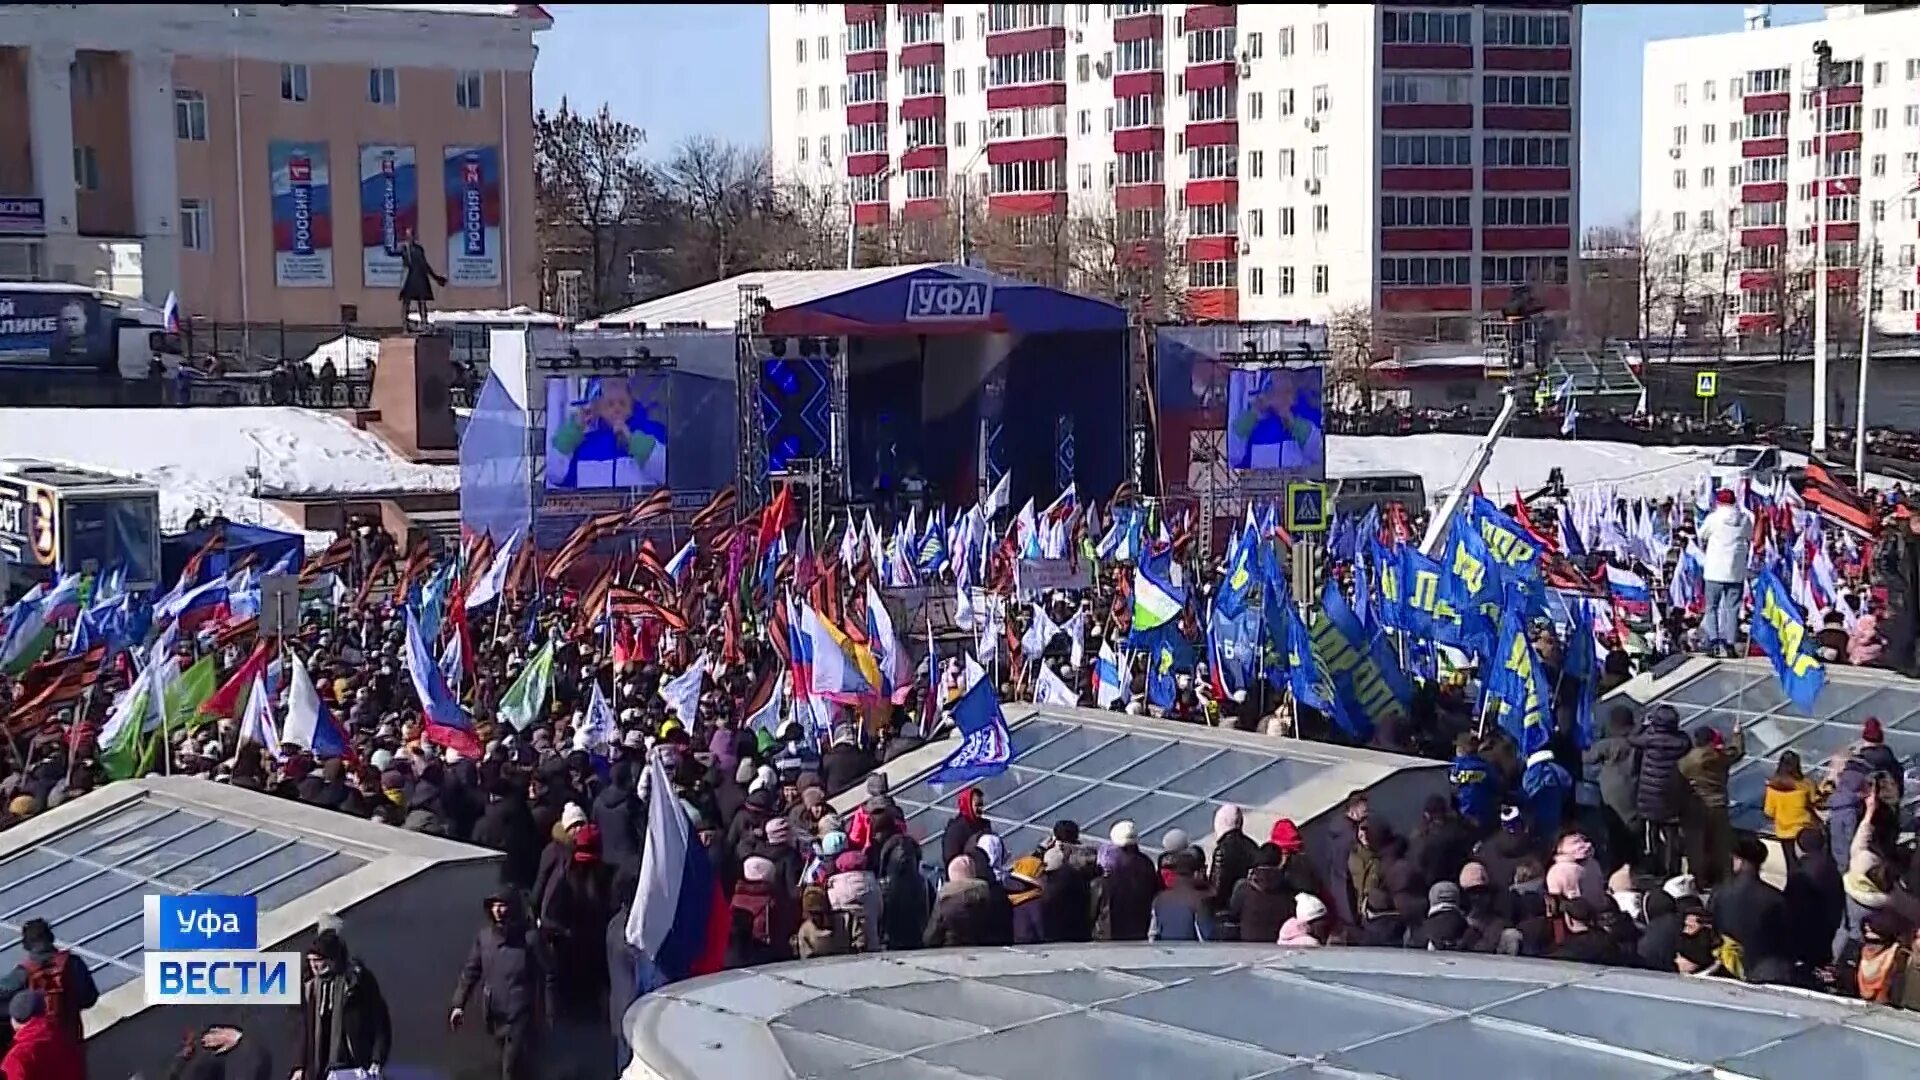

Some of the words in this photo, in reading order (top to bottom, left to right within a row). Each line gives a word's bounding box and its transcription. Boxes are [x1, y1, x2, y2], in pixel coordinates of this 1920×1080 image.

[466, 163, 479, 183] 24
[294, 187, 311, 250] РОССИЯ
[466, 189, 481, 252] РОССИЯ
[918, 284, 982, 315] УФА
